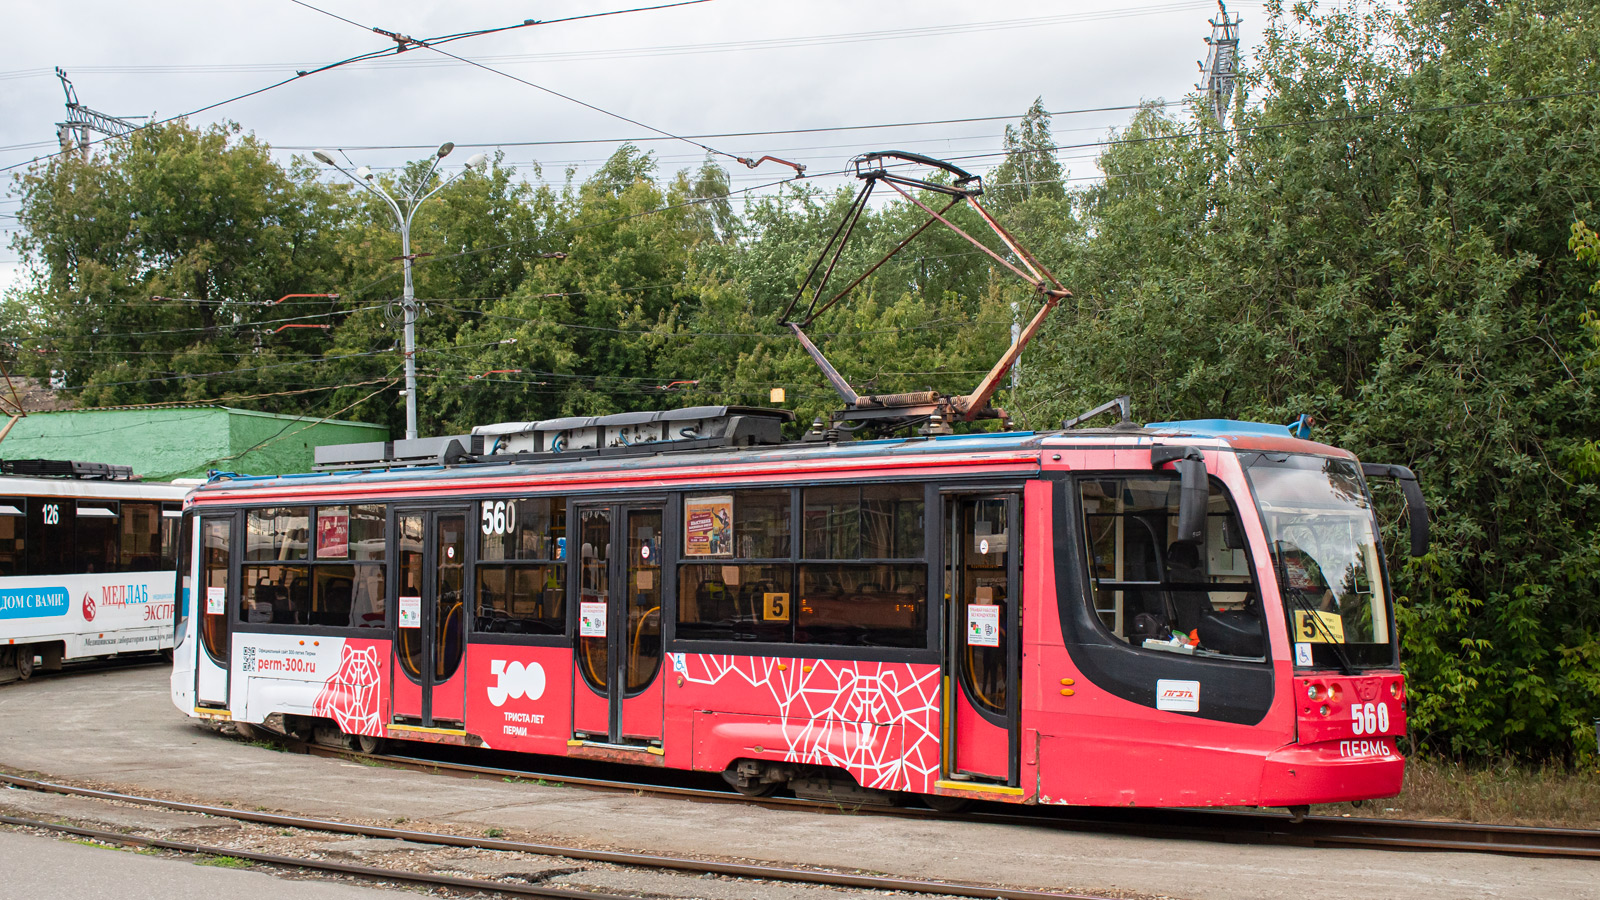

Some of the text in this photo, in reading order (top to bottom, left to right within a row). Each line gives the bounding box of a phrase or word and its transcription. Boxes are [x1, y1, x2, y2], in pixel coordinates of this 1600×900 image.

[42, 504, 59, 525] 126
[482, 500, 516, 535] 560
[0, 593, 64, 610] ДОМ С ВАМИ!
[102, 584, 148, 609] МЕДЛАБ
[772, 596, 784, 617] 5
[1303, 614, 1316, 638] 5
[258, 658, 316, 673] perm-300.ru
[487, 659, 546, 707] 300
[504, 711, 545, 725] ТРИСТА ЛЕТ
[1351, 702, 1389, 735] 560
[503, 725, 528, 736] ПЕРМИ
[1340, 740, 1390, 757] ПЕРМЬ
